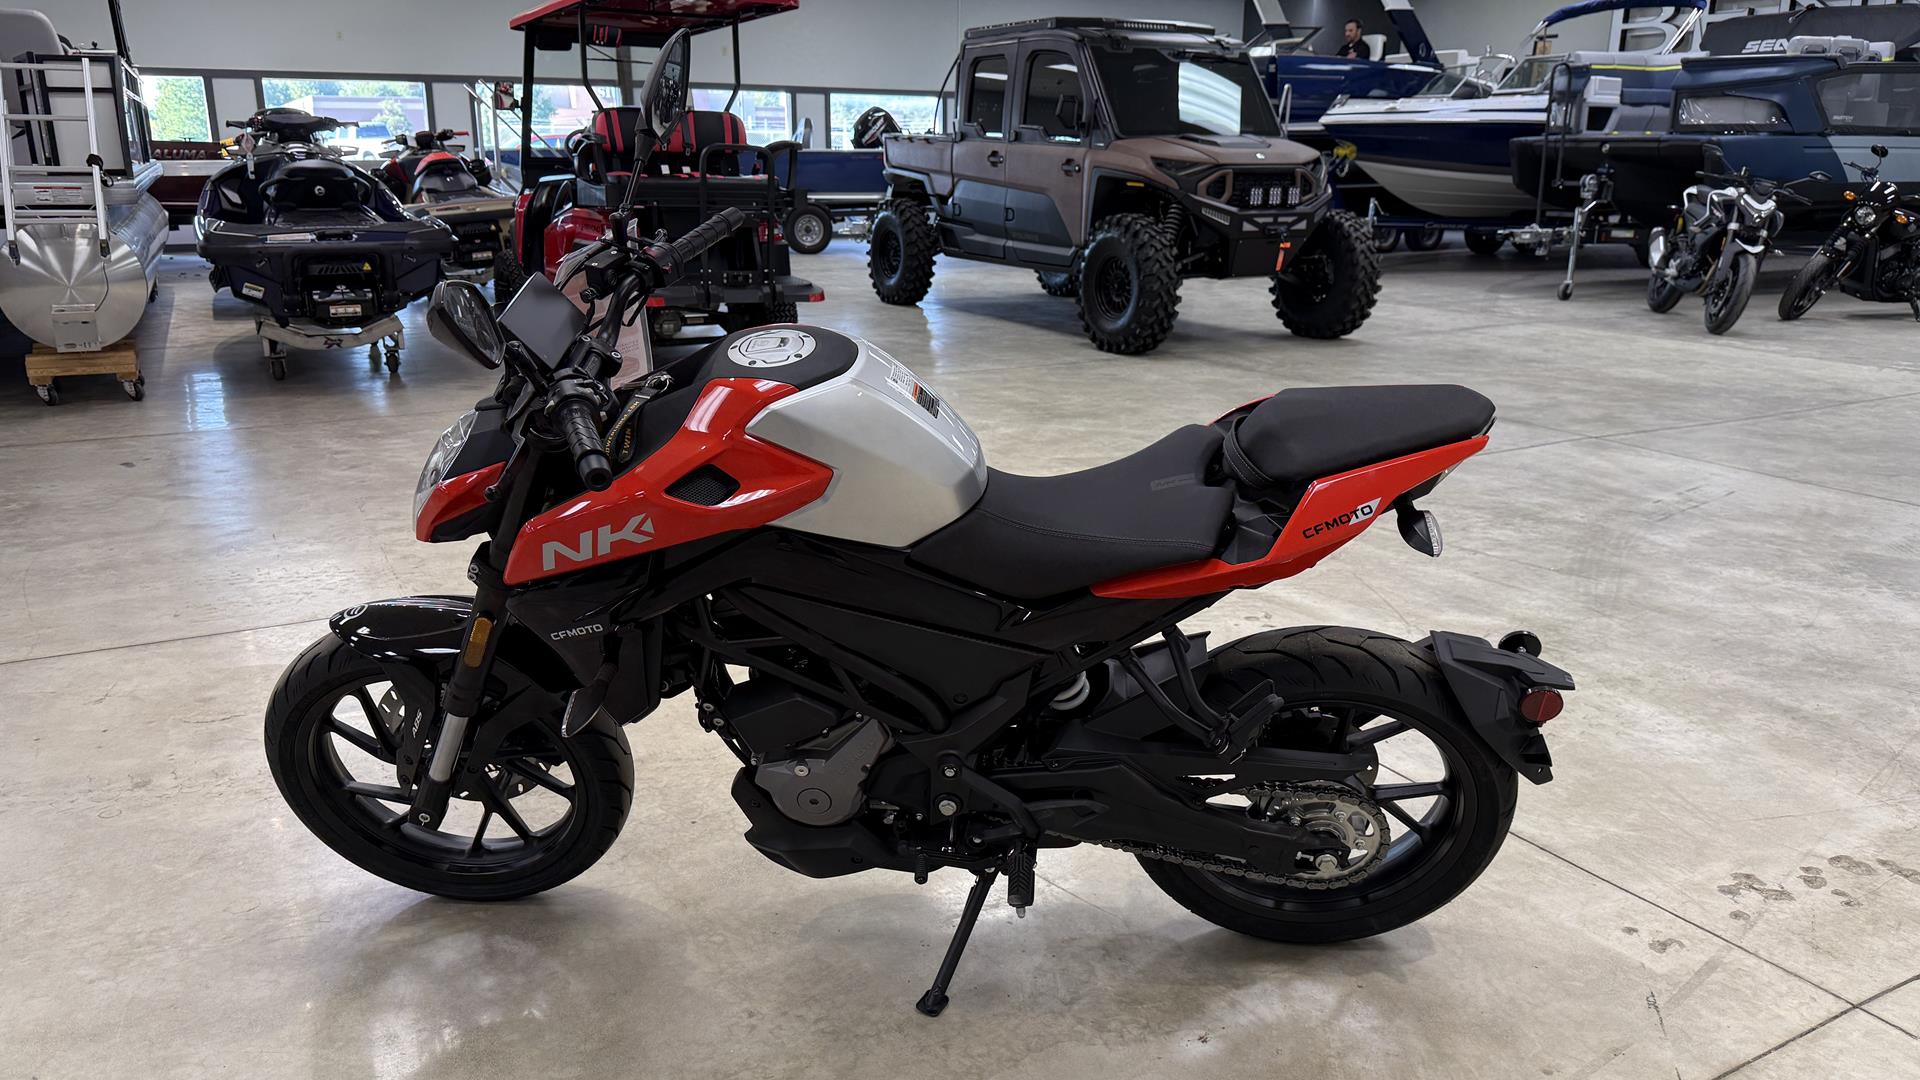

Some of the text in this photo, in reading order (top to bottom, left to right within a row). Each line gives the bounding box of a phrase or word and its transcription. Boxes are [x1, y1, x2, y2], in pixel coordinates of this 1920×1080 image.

[152, 148, 208, 160] ALUMA
[1302, 504, 1374, 539] CFMOTO
[542, 512, 655, 571] NK
[550, 623, 604, 641] CFMOTO
